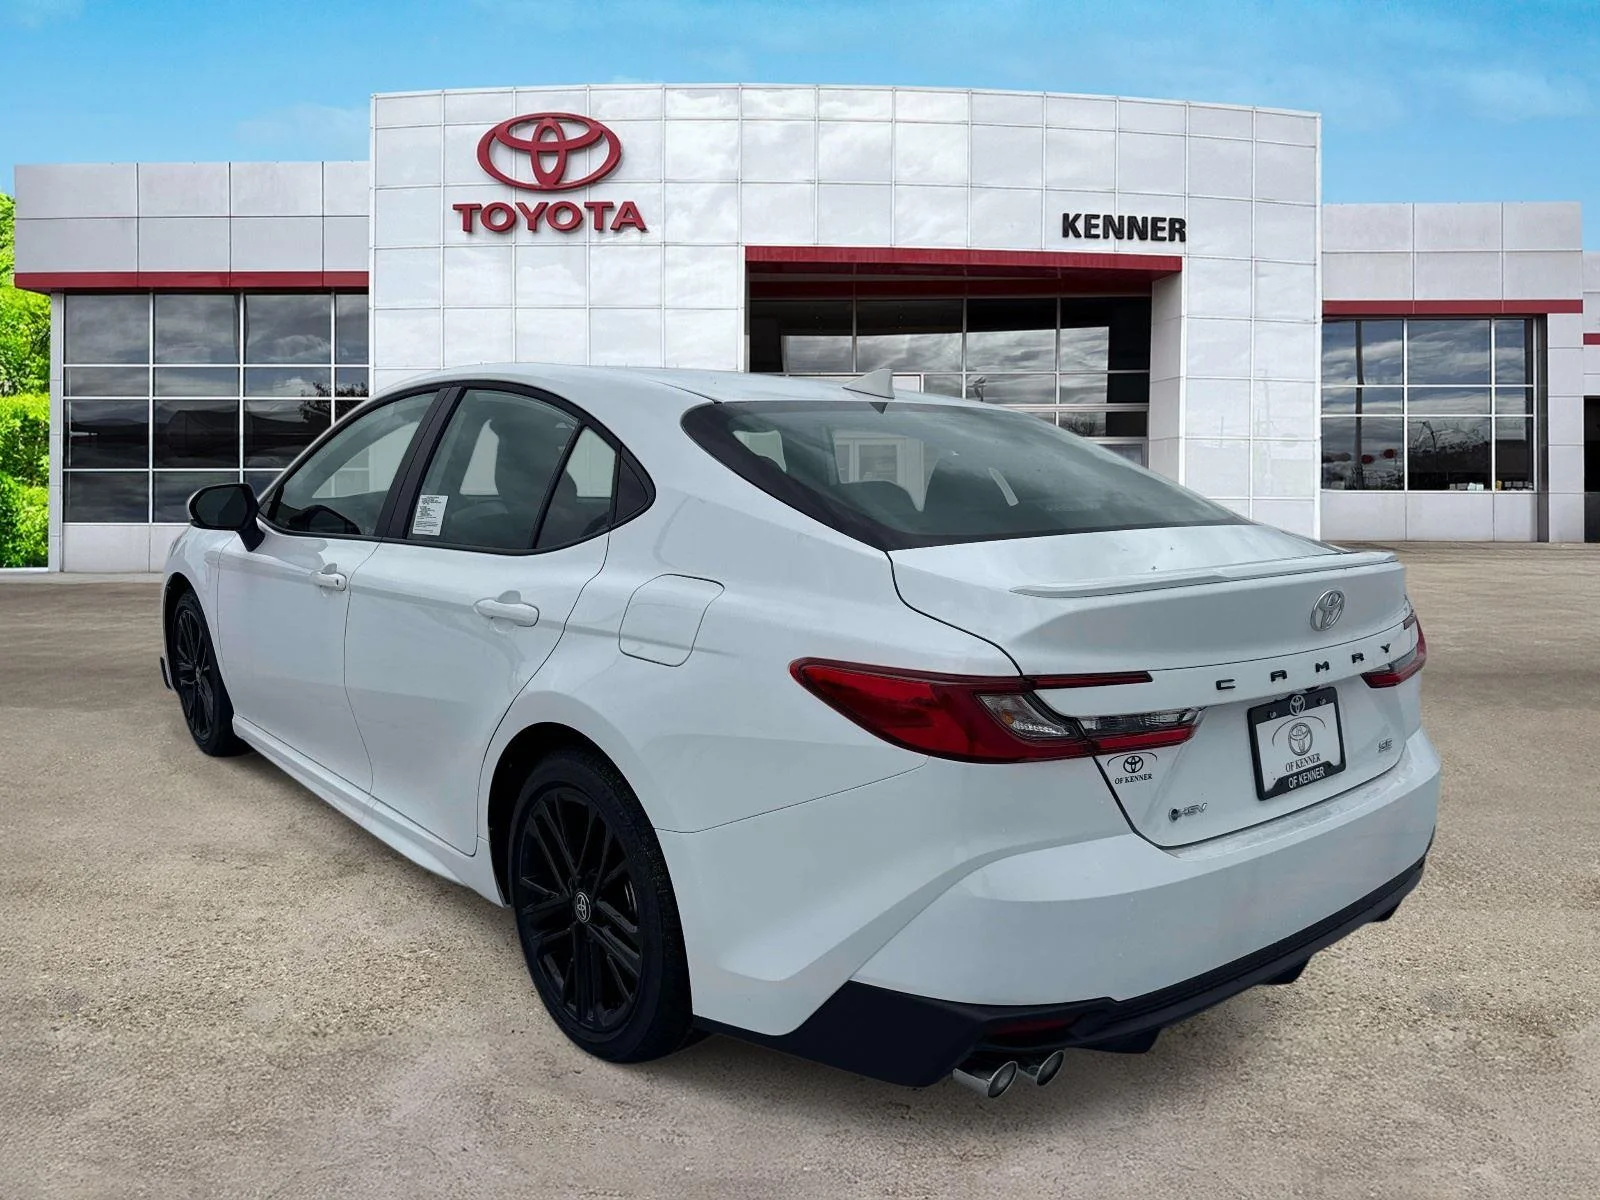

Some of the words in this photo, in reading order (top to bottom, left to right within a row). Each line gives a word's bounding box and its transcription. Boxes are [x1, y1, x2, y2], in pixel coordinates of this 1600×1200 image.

[452, 201, 648, 233] TOYOTA
[1062, 212, 1187, 243] KENNER
[1215, 642, 1391, 692] CAMRY
[1286, 761, 1295, 773] OF
[1295, 752, 1321, 770] KENNER
[1114, 777, 1124, 785] OF
[1124, 773, 1153, 784] KENNER
[1288, 775, 1298, 789] OF
[1299, 766, 1326, 785] KENNER
